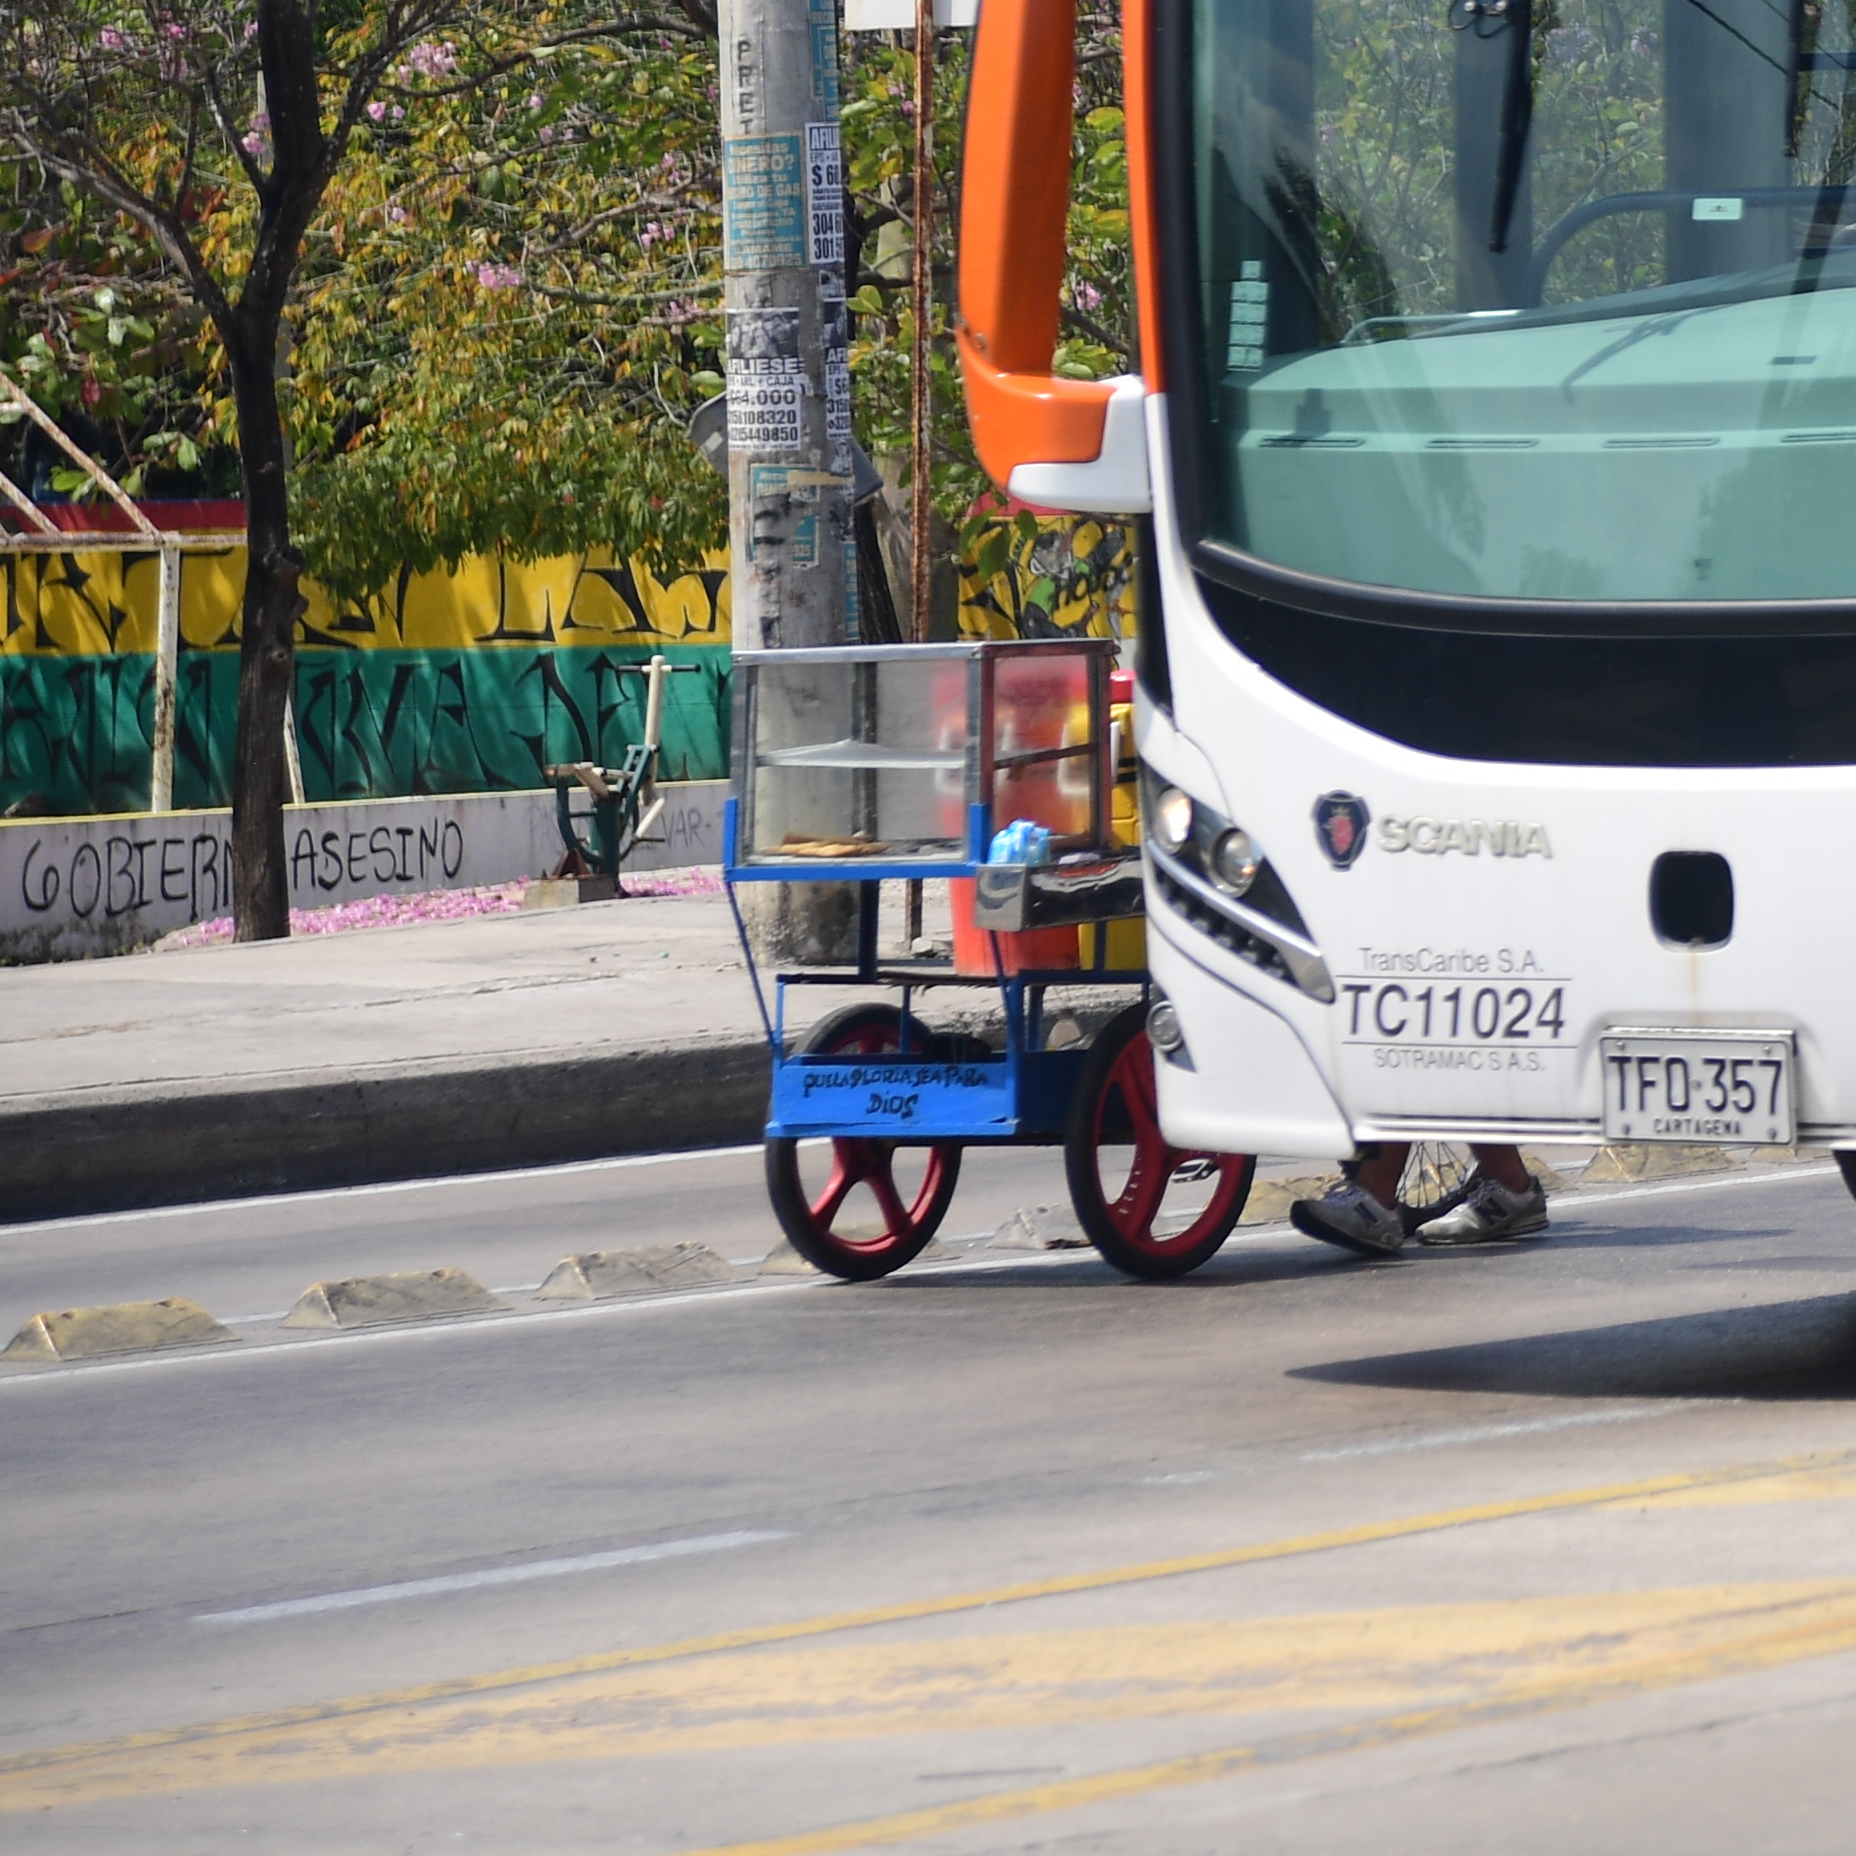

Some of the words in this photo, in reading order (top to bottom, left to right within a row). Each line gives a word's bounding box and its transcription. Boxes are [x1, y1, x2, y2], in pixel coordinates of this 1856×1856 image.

[766, 375, 794, 386] CAJA
[1378, 814, 1552, 860] SCANIA
[22, 834, 233, 921] GOBIER
[291, 817, 464, 891] ASESINO
[1359, 947, 1489, 973] TransCaribe
[1498, 948, 1544, 973] S.A.
[1342, 983, 1567, 1039] TC11024
[1373, 1048, 1484, 1071] SOTRAMAC
[1653, 1115, 1743, 1137] CARTAGENA
